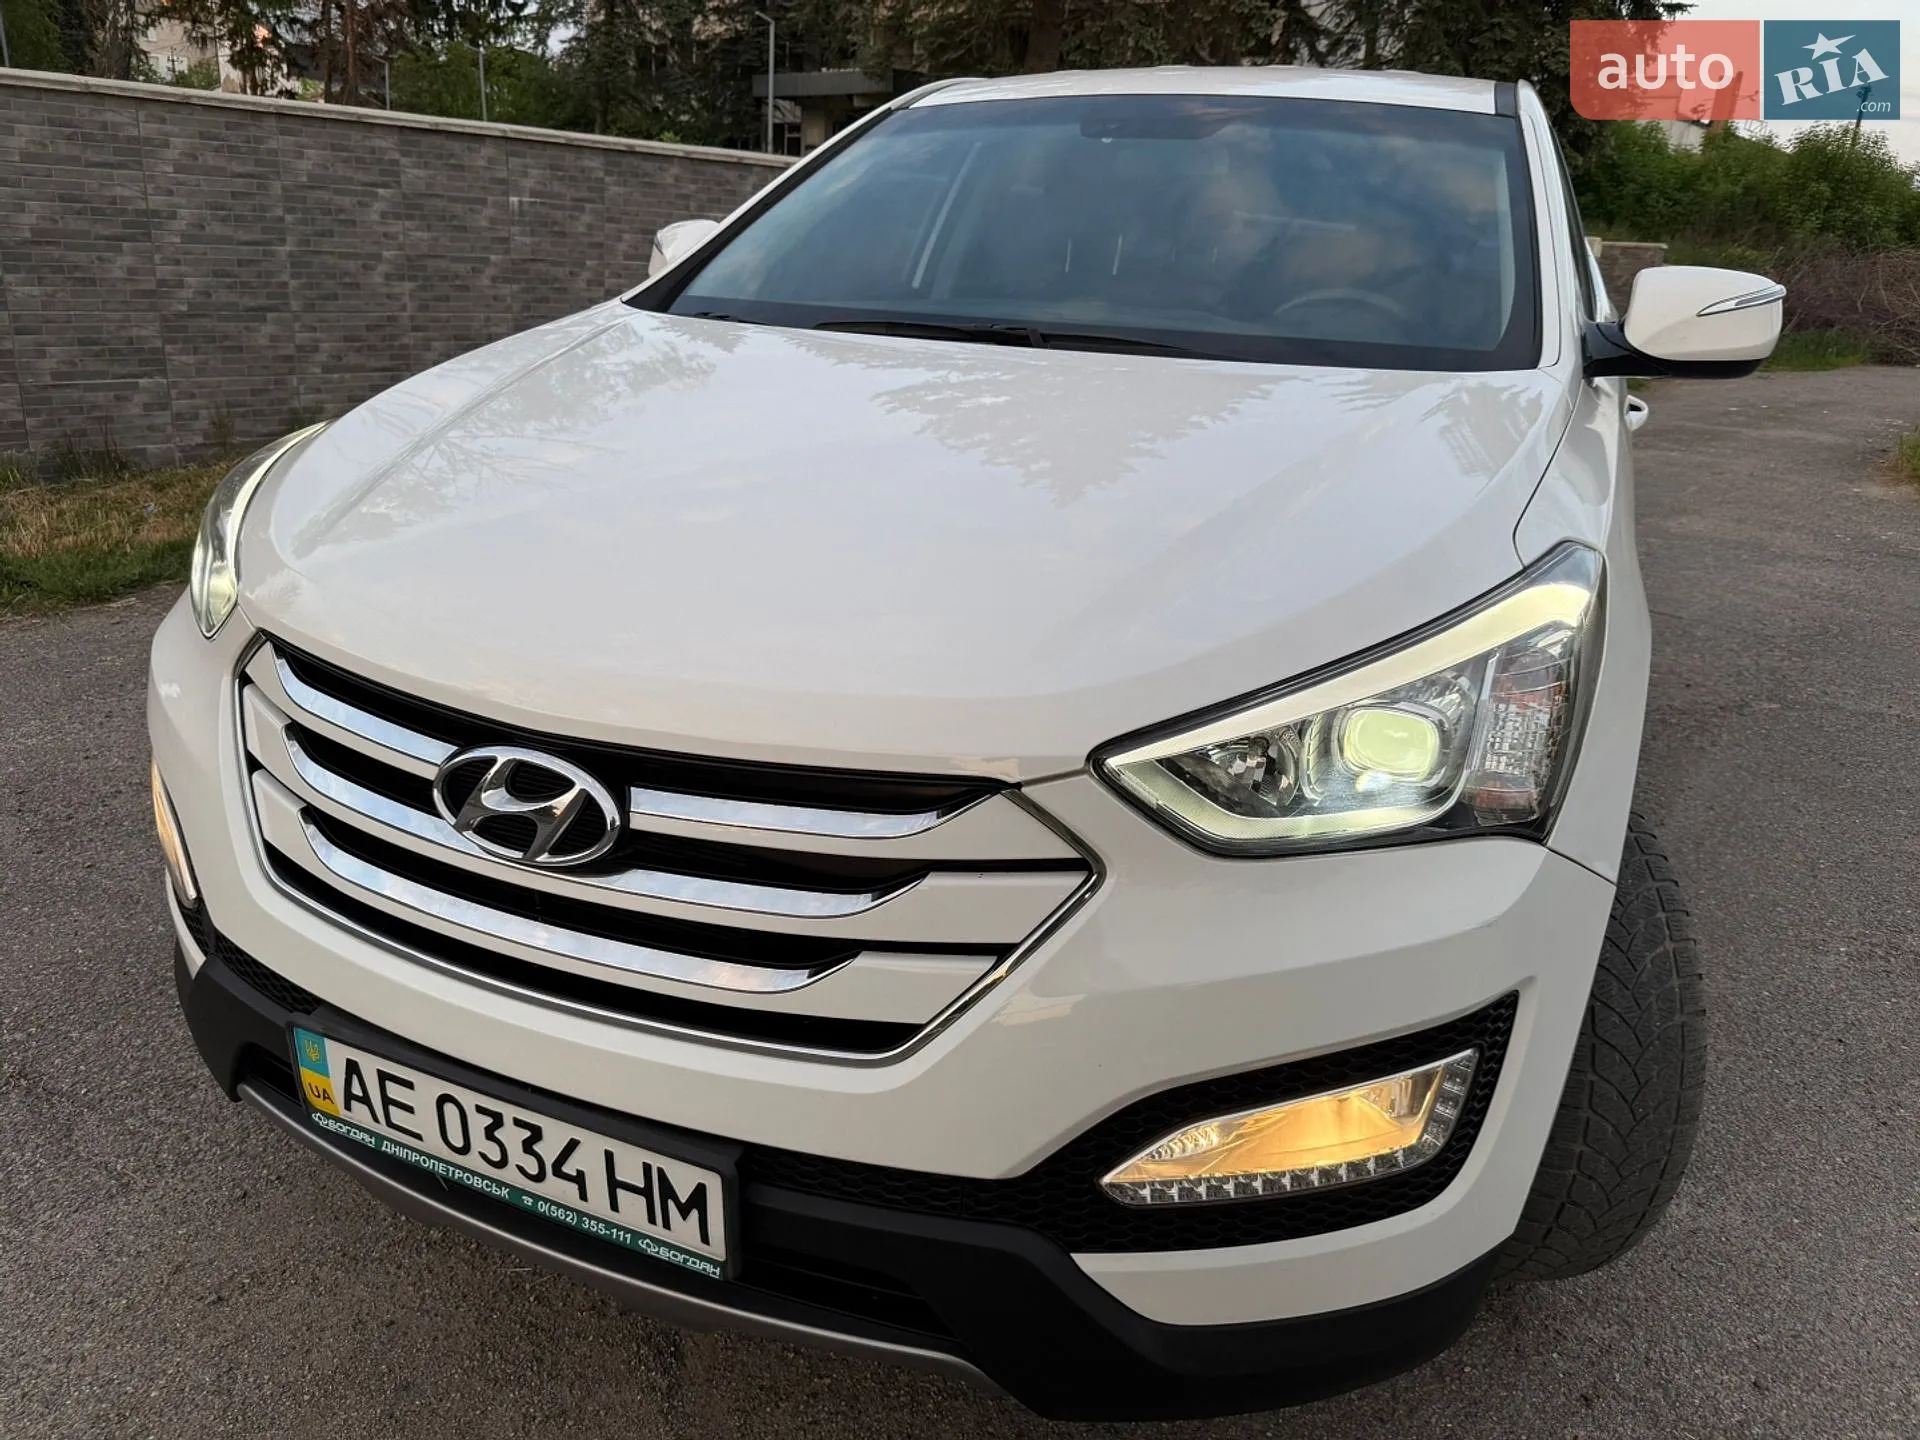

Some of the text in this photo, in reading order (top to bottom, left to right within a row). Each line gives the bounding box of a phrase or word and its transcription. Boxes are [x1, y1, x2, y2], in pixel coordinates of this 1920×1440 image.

[307, 1082, 335, 1105] UA
[343, 1057, 711, 1247] AE 0334 HM
[381, 1139, 510, 1200] ДНІПРОПЕТРОВСЬК
[537, 1200, 578, 1225] 0(562)
[581, 1216, 632, 1245] 355-111
